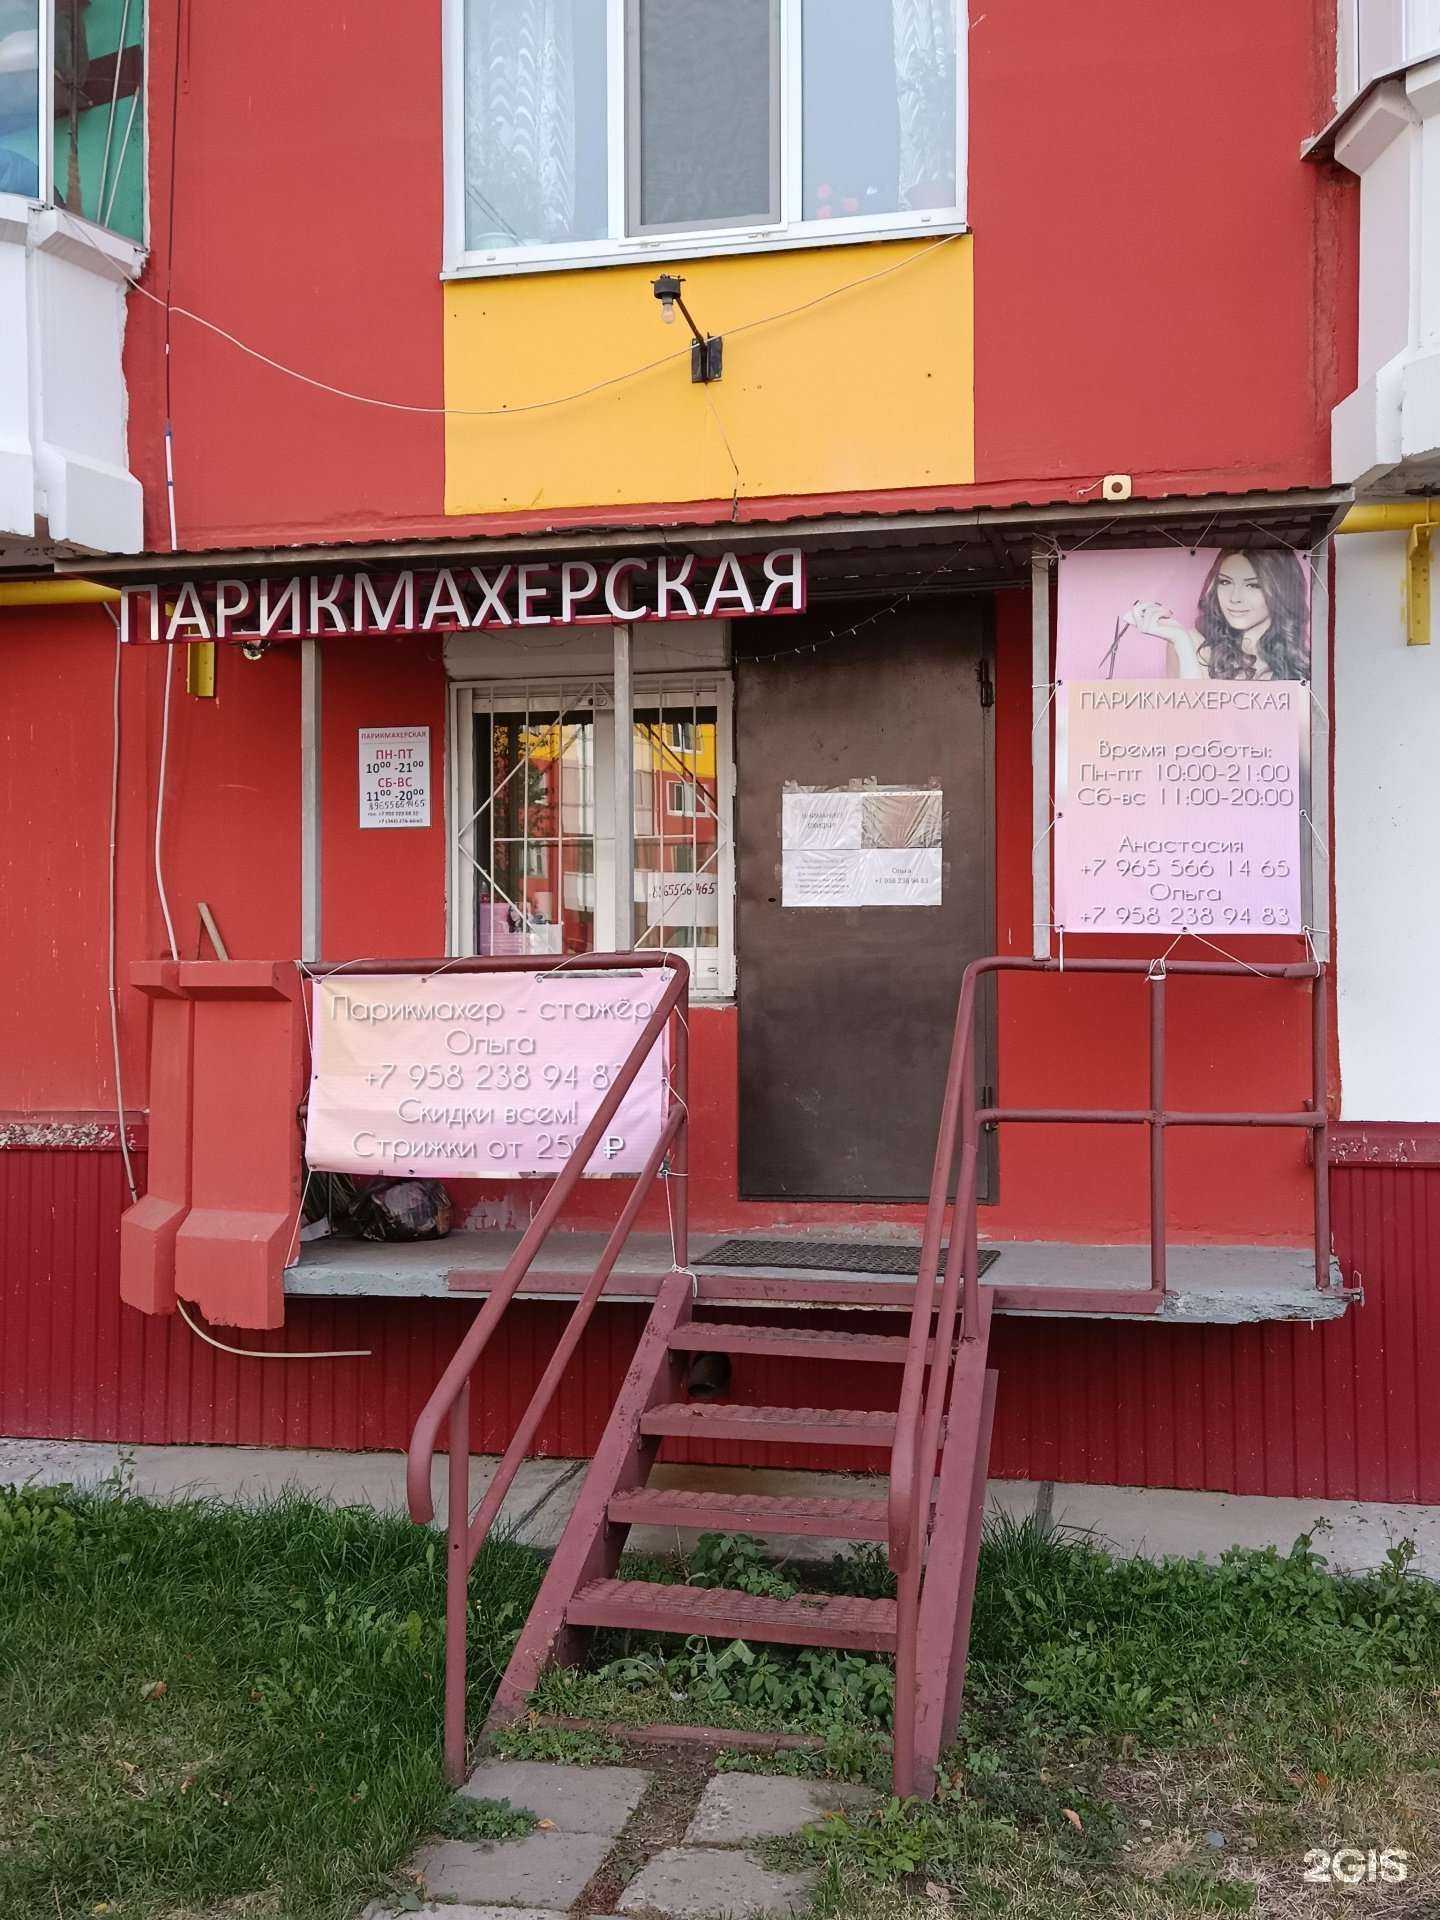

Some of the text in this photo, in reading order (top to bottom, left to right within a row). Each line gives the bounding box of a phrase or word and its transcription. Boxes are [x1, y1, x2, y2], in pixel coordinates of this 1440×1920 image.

[121, 547, 805, 643] ПАРИКМАХЕРСКАЯ
[1080, 690, 1291, 711] ПАРИКМАХЕРСКАЯ
[361, 731, 427, 739] ПАРИКМАХЕРСКАЯ
[376, 748, 414, 760] ПН-ПТ
[1096, 739, 1273, 761] Время работы:
[377, 777, 413, 788] СБ-ВС
[1079, 763, 1290, 783] Пн-пт 10:00-21:00
[1077, 787, 1294, 807] Сб-вс 11:00-20:00
[1118, 835, 1244, 854] Анастасия
[1080, 859, 1290, 878] +7 965 566 14 65
[1149, 883, 1222, 902] Ольга
[1080, 907, 1290, 926] +7 958 238 94 83
[331, 994, 505, 1025] Парикмахер
[539, 998, 654, 1026] стажёр
[444, 1028, 537, 1055] Ольга
[365, 1063, 398, 1089] +7
[408, 1063, 464, 1090] 958
[475, 1063, 530, 1090] 238
[543, 1063, 578, 1090] 94
[396, 1097, 579, 1130] Скидки всем!
[352, 1129, 478, 1162] Стрижки
[488, 1139, 523, 1159] от
